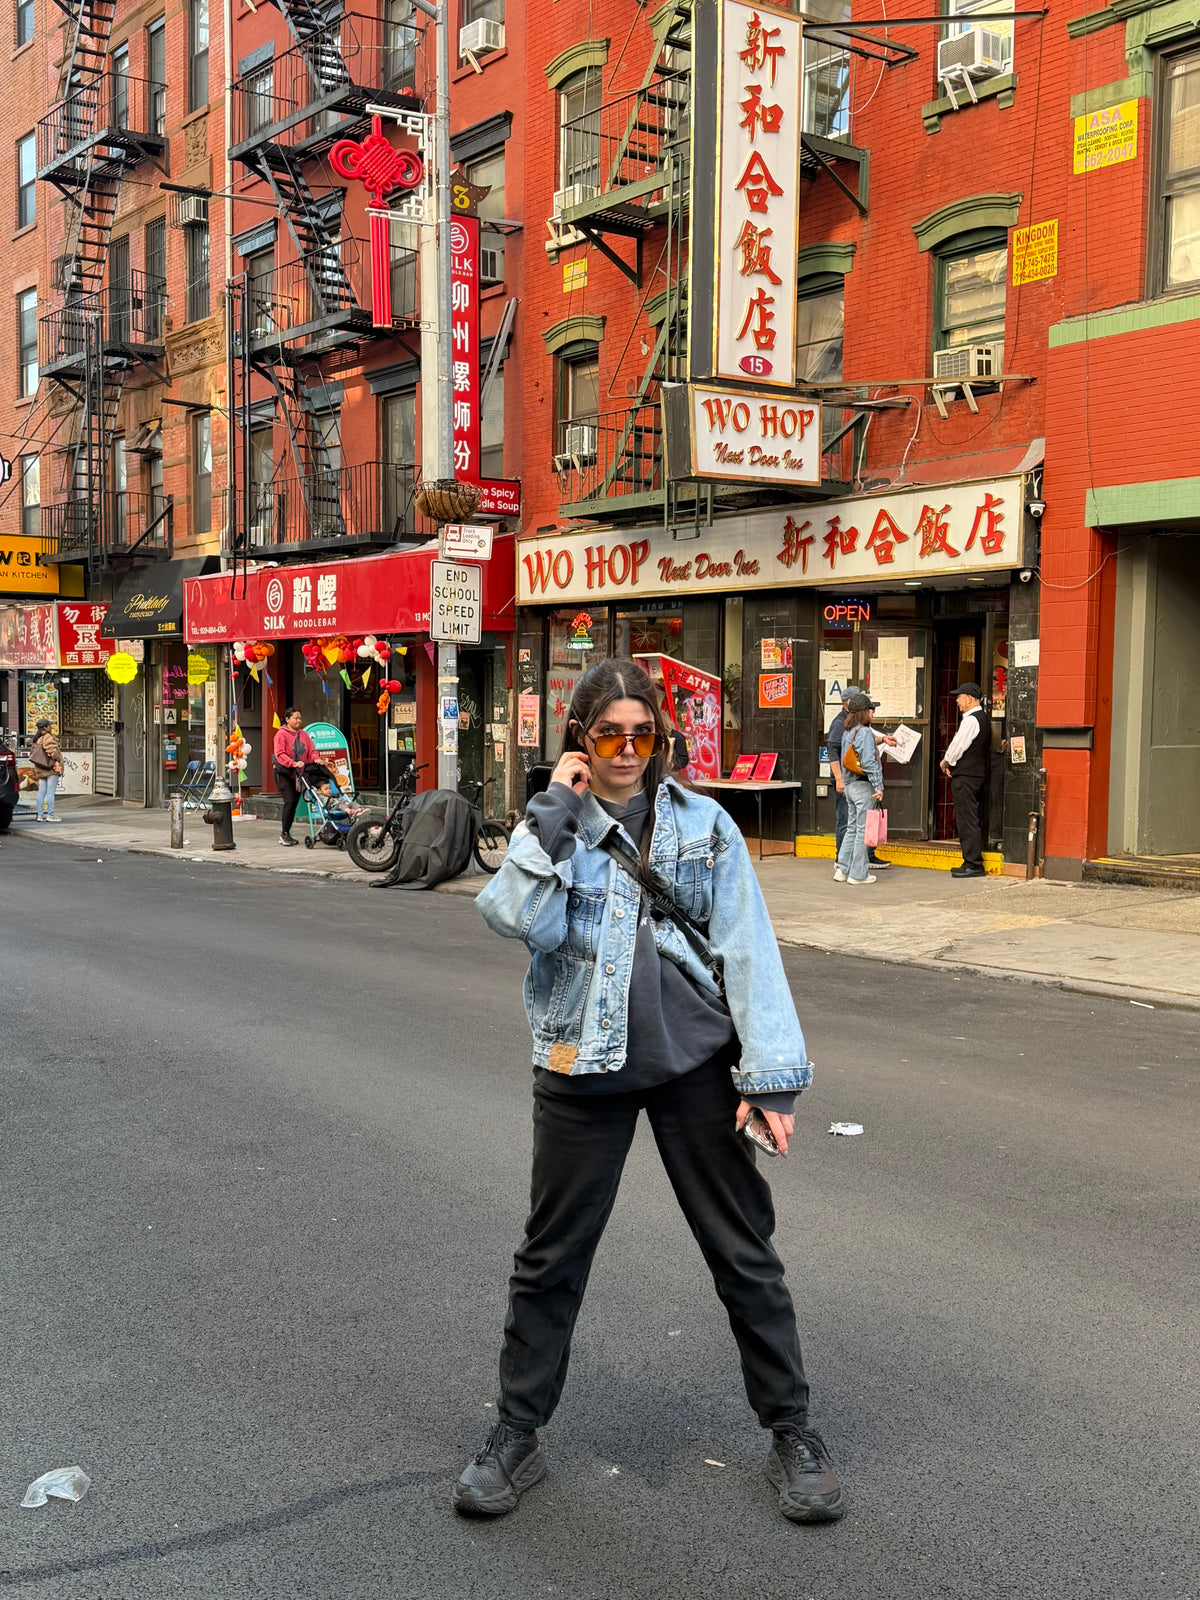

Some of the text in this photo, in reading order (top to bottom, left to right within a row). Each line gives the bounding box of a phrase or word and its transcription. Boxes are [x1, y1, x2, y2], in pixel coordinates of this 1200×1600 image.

[1089, 108, 1122, 129] ASA
[1077, 125, 1117, 142] WATERPROOFING
[734, 11, 786, 351] 新和合飯店
[1016, 224, 1055, 246] KINGDOM
[451, 256, 473, 271] ILK
[749, 357, 763, 373] 15
[702, 398, 814, 440] WO HOP
[713, 441, 804, 470] Next Door Inc
[491, 487, 515, 499] Spicy
[497, 501, 519, 512] Soup
[777, 492, 1007, 574] 新和合飯店
[523, 539, 761, 594] WO HOP Next Door Inc
[12, 571, 48, 579] KITCHEN
[446, 569, 468, 583] END
[434, 586, 478, 602] SCHOOL
[414, 611, 431, 622] 13 MO
[438, 604, 474, 619] SPEED
[824, 605, 870, 621] OPEN
[264, 616, 285, 630] SILK
[442, 622, 470, 636] LIMIT
[550, 678, 565, 690] WO
[686, 676, 711, 692] ATM
[829, 680, 842, 695] A
[166, 710, 175, 720] A
